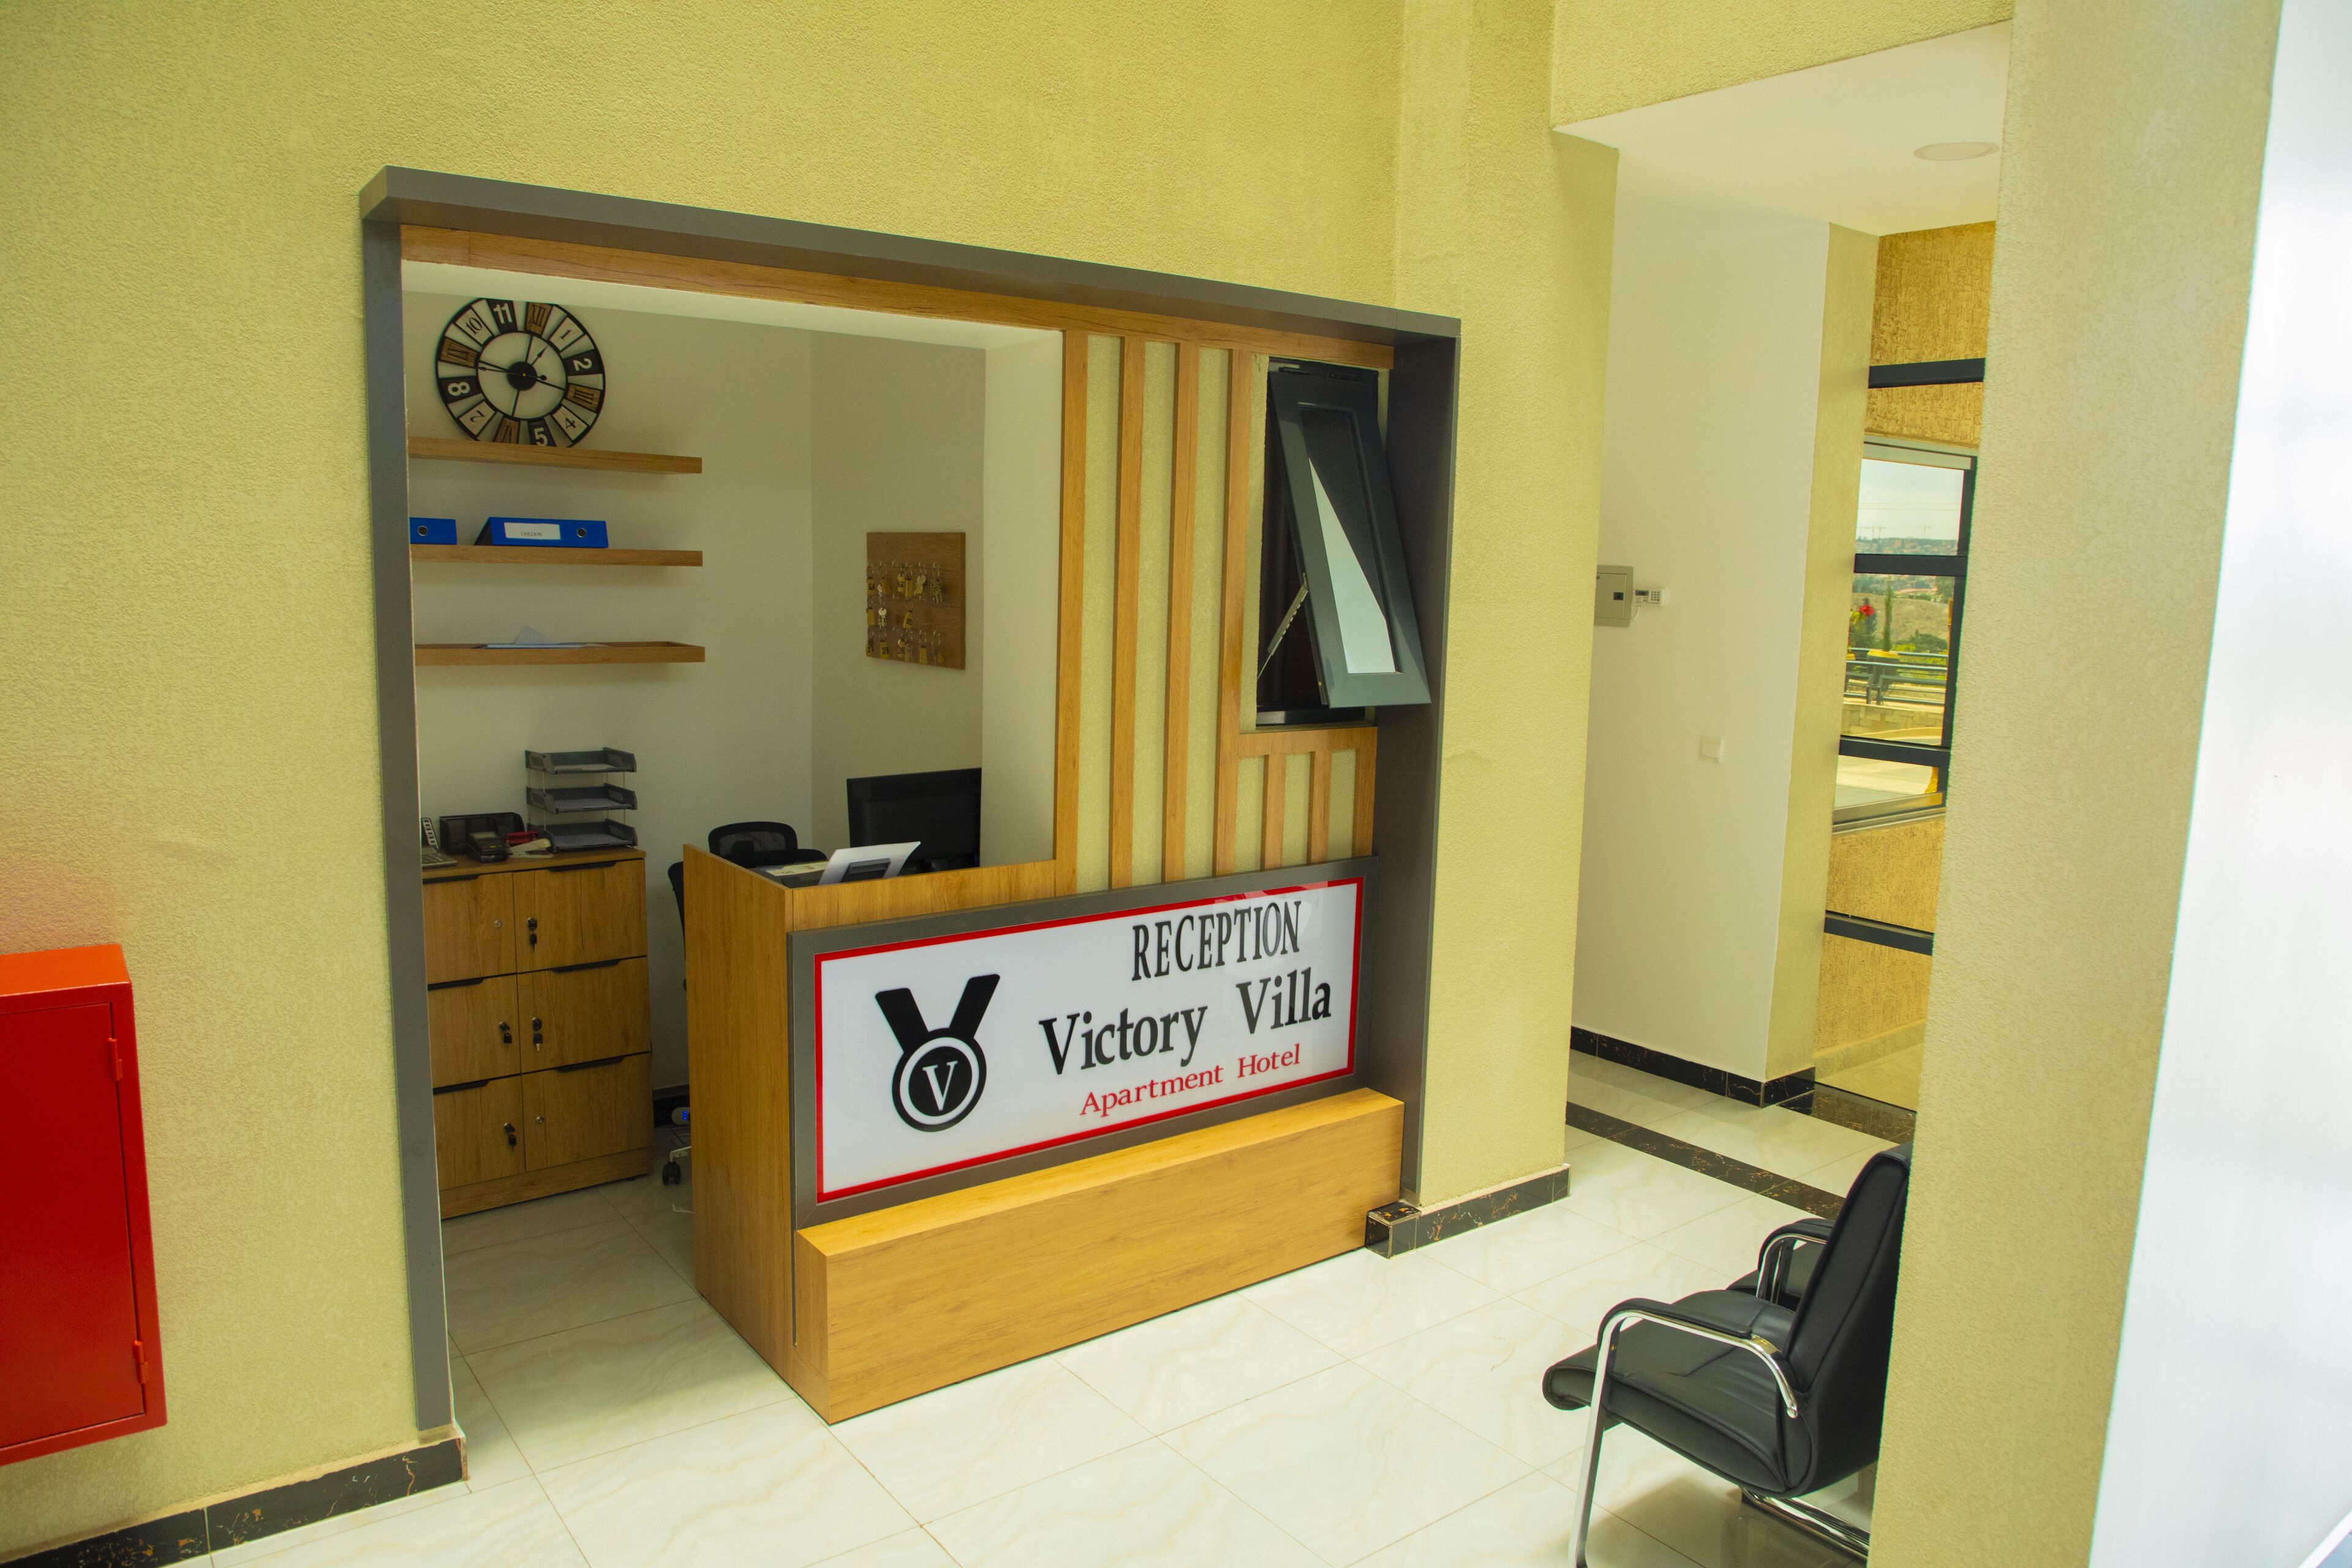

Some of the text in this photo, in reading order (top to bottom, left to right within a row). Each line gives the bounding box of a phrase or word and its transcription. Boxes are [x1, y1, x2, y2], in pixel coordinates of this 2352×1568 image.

[493, 303, 513, 325] 11
[529, 304, 546, 328] XII
[466, 317, 483, 335] 10
[560, 329, 572, 341] 1
[573, 358, 592, 371] 2
[447, 381, 470, 396] 8
[470, 410, 486, 423] 7
[565, 417, 576, 430] 4
[533, 427, 549, 447] 5
[1131, 900, 1302, 982] RECEPTION
[1038, 967, 1333, 1072] Victory Villa
[922, 1061, 958, 1111] V
[1080, 1043, 1300, 1118] Apartment Hotel
